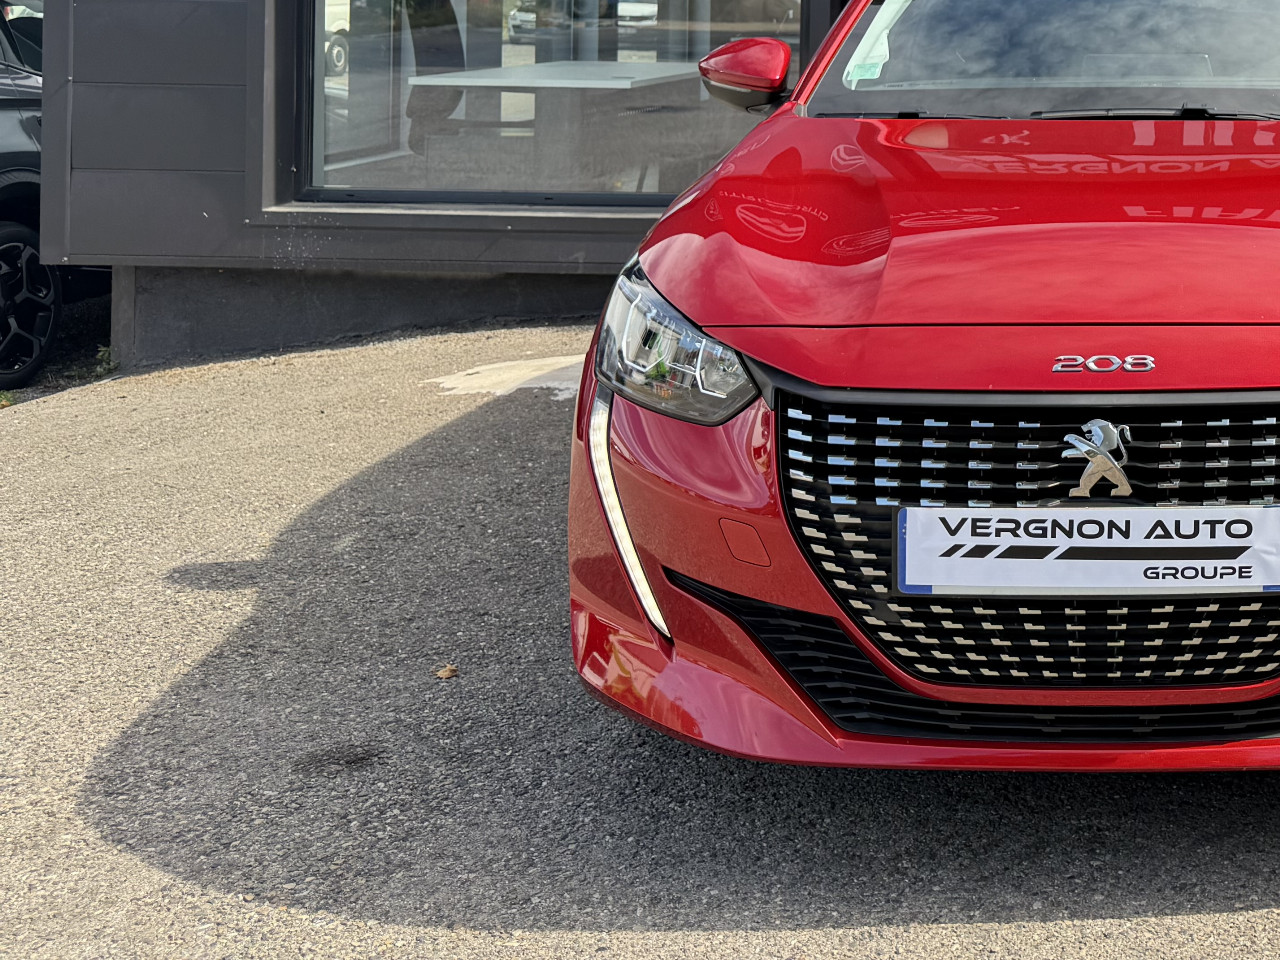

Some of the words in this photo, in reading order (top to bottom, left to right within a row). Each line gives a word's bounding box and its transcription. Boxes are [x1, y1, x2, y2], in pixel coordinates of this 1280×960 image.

[1052, 354, 1156, 372] 208
[938, 516, 1131, 540] VERGNON
[1143, 518, 1253, 540] AUTO
[1143, 565, 1253, 580] GROUPE
